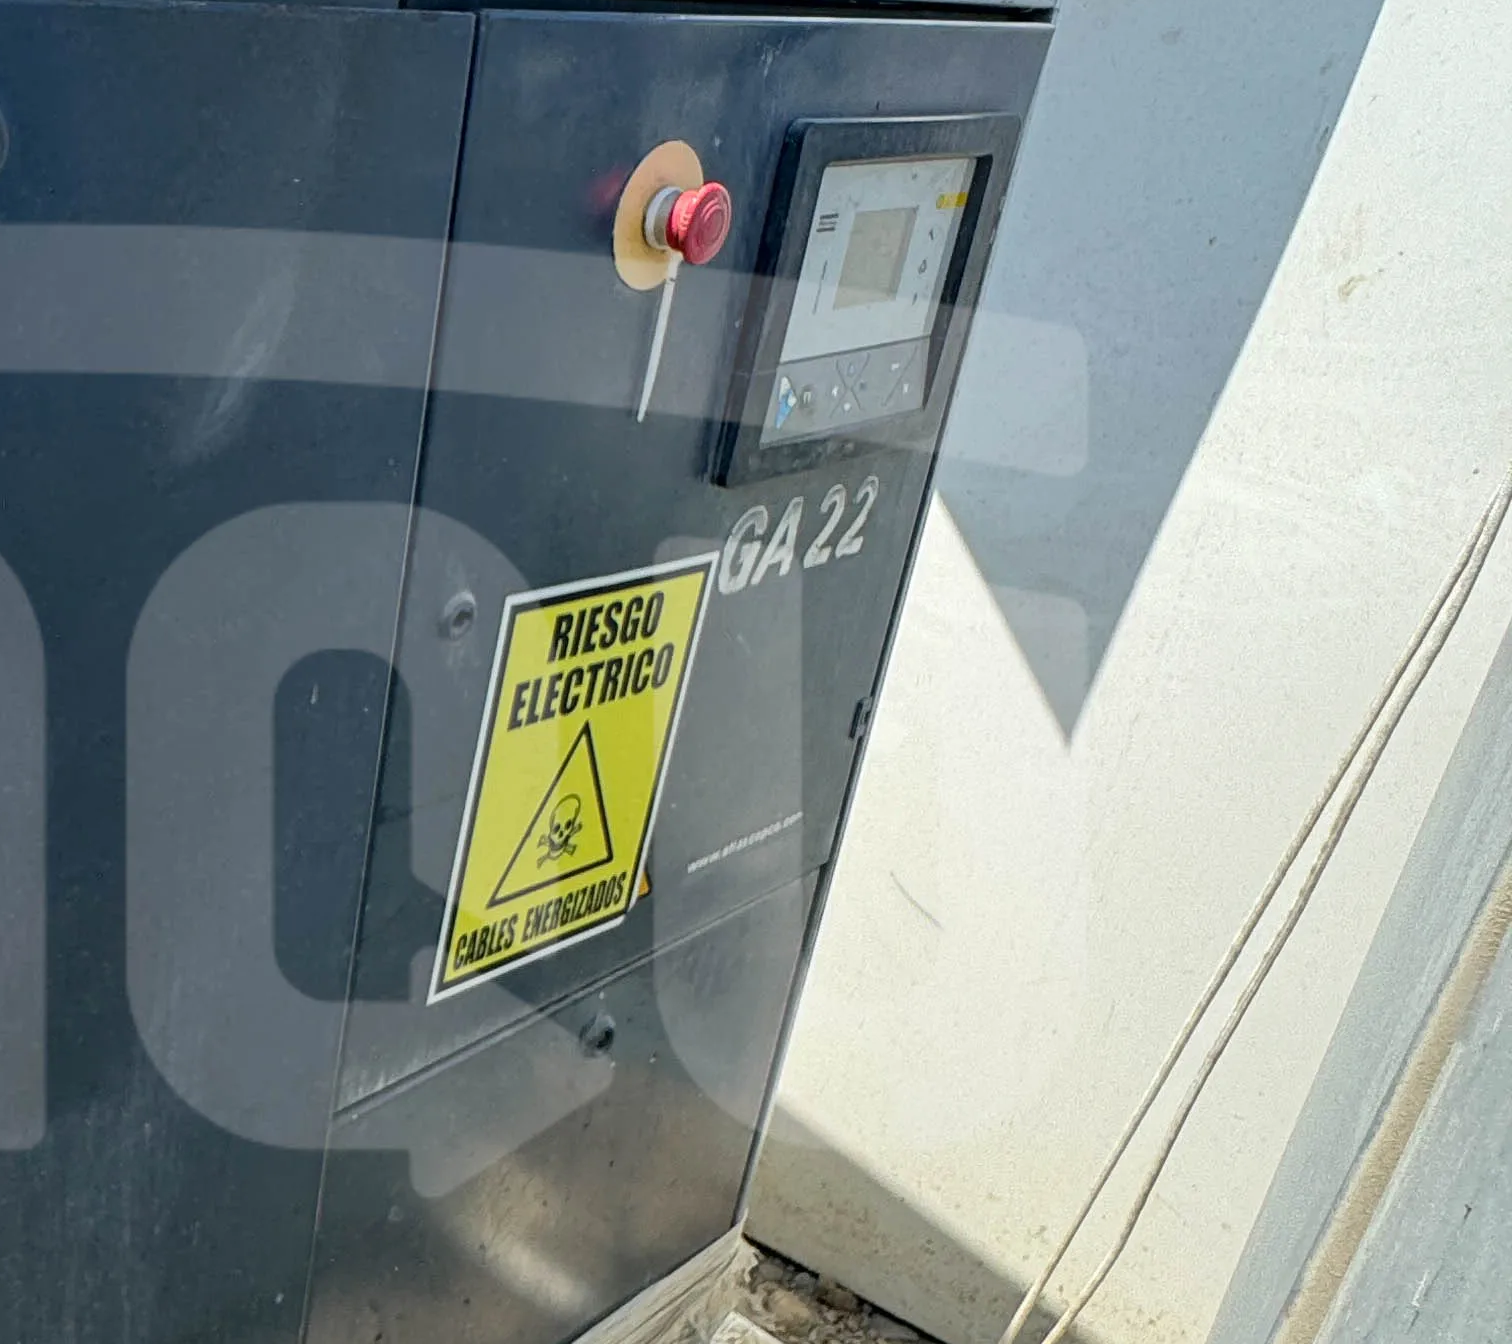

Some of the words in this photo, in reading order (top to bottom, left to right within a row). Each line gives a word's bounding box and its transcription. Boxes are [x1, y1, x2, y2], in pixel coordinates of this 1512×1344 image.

[718, 496, 804, 594] GA
[803, 475, 879, 568] 22
[547, 590, 665, 665] RIESGO
[507, 641, 675, 732] ELECTRICO
[454, 912, 519, 970] CABLES
[522, 870, 628, 942] ENERGIZADOS
